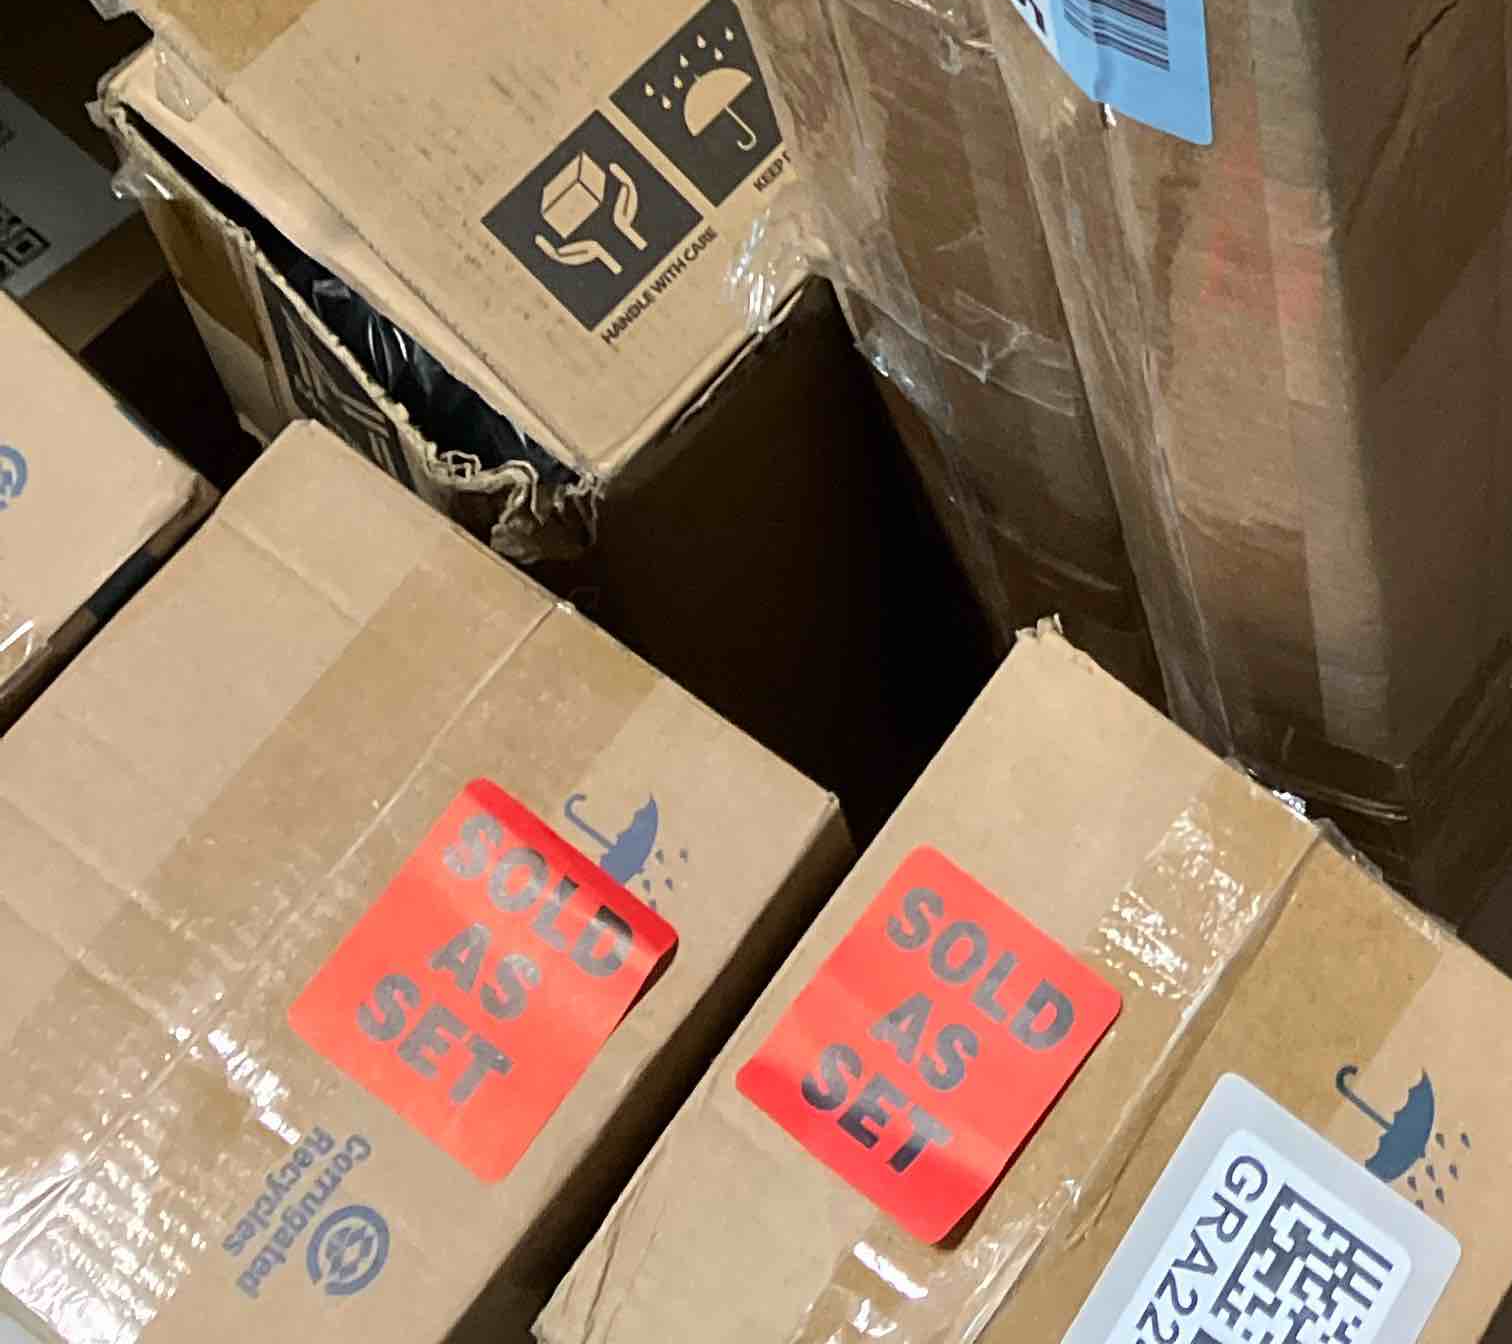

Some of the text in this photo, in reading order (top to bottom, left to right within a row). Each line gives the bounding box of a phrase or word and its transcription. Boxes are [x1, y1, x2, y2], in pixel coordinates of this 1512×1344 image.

[752, 160, 784, 193] KEEP
[600, 225, 719, 346] HANDLE WITH CARE
[442, 811, 640, 978] SOLD
[427, 920, 541, 1023] AS
[886, 886, 1078, 1054] SOLD
[356, 974, 515, 1108] SET
[868, 993, 980, 1093] AS
[800, 1042, 953, 1176] SET
[222, 1126, 336, 1257] Recycles
[236, 1134, 372, 1300] Corrugated
